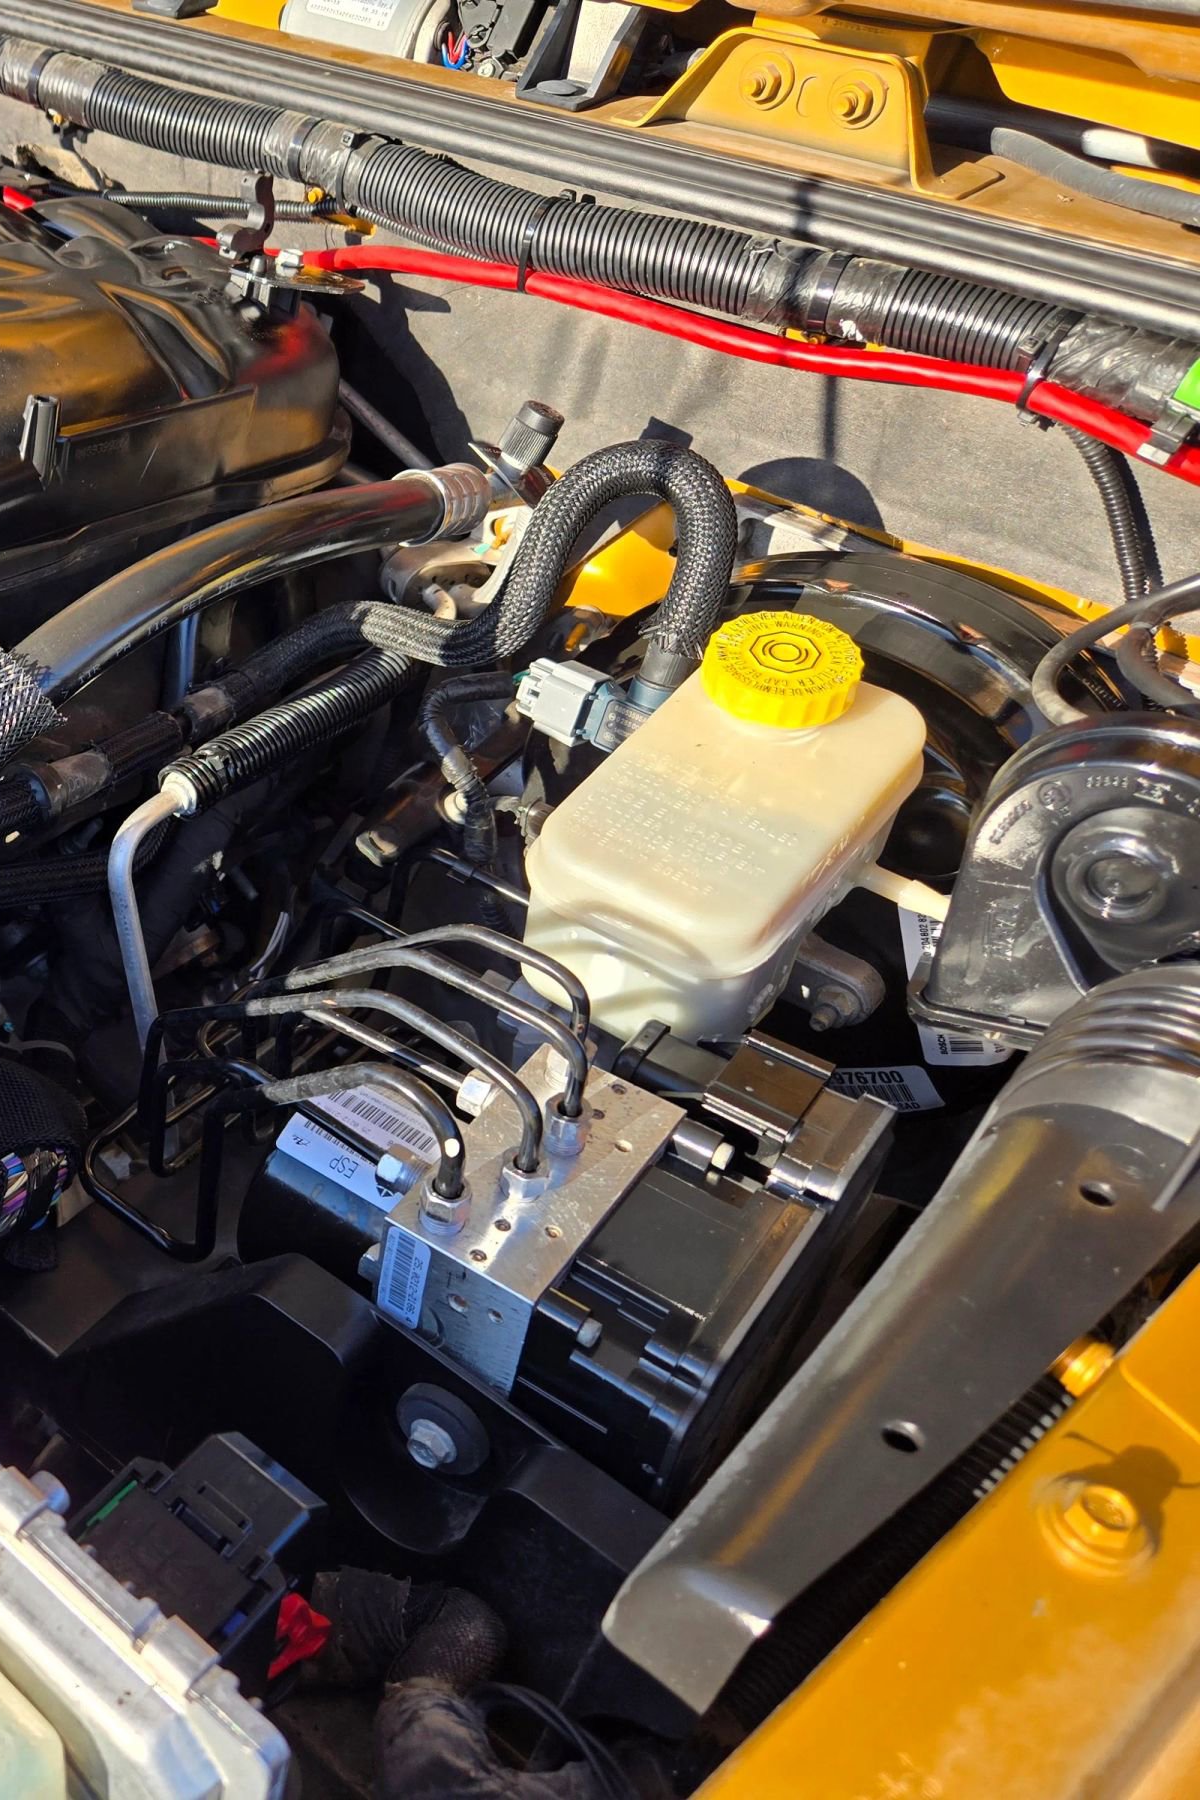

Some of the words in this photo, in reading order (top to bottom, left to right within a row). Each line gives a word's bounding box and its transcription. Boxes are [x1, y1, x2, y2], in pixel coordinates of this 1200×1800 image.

[937, 1034, 949, 1055] BOSCH
[832, 1070, 905, 1085] 976700
[329, 1155, 359, 1179] ESP
